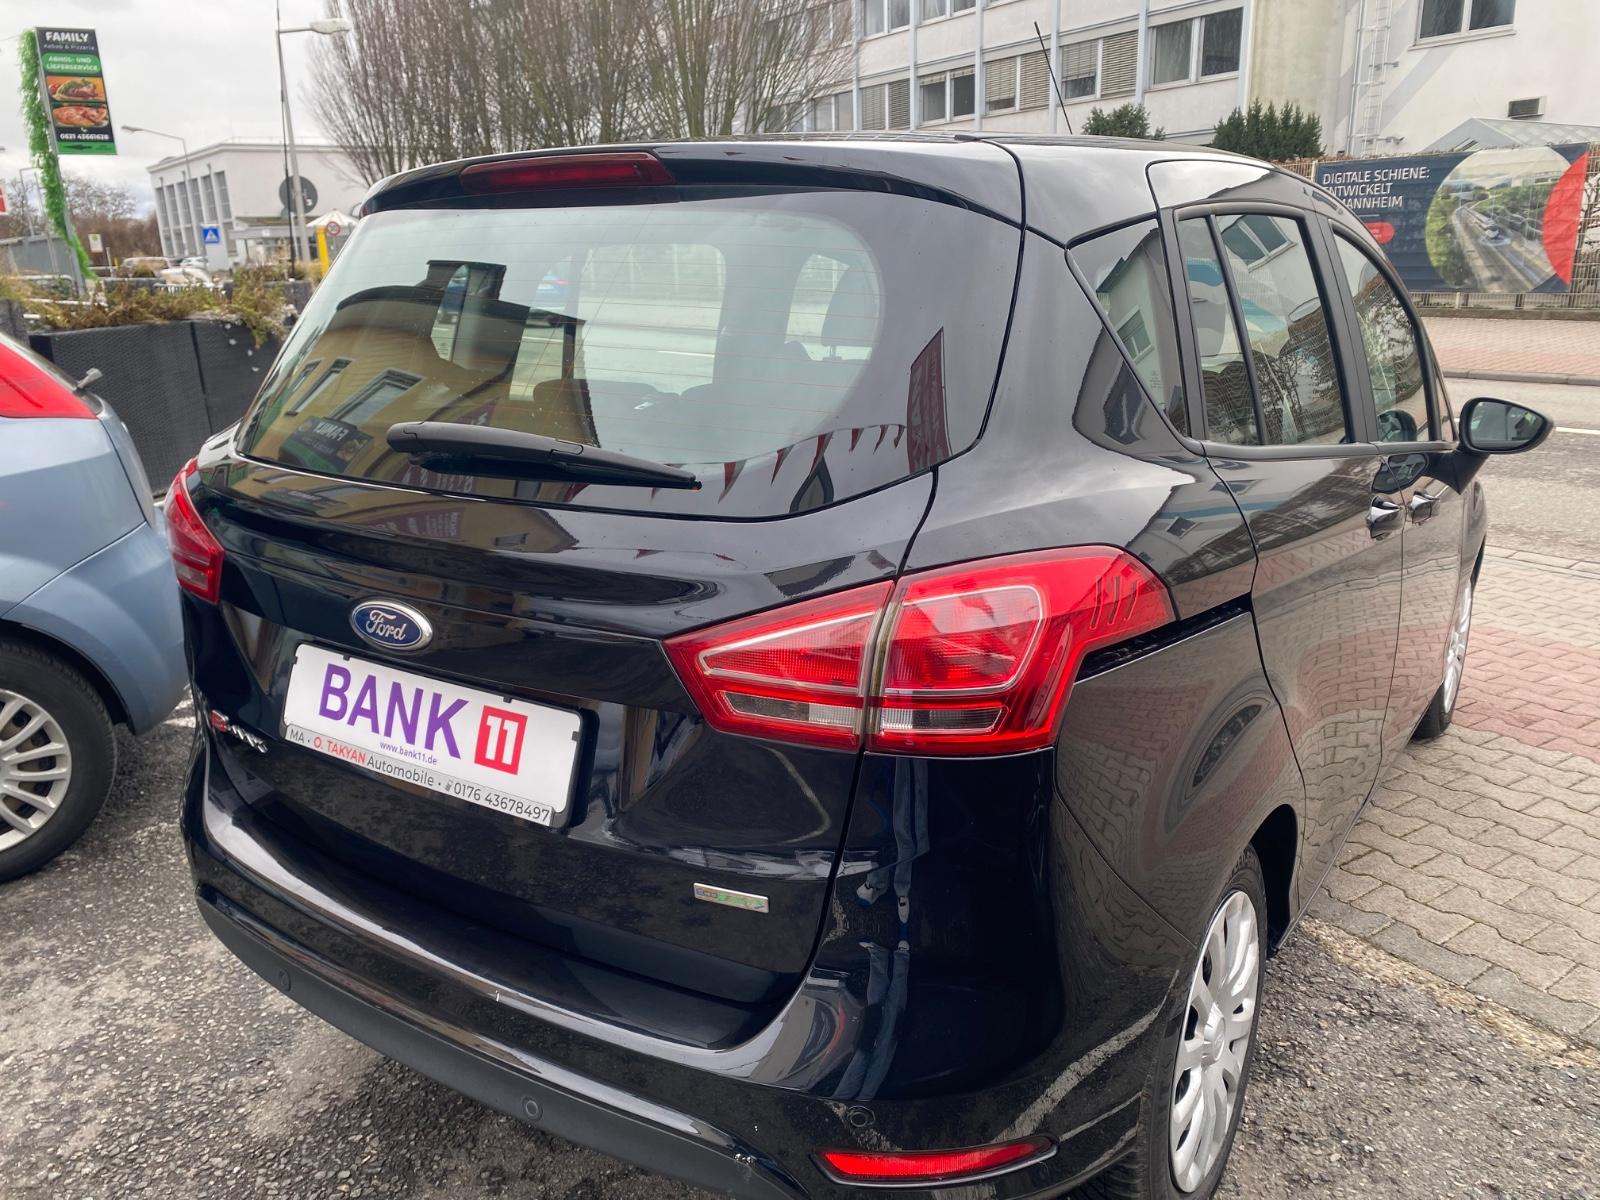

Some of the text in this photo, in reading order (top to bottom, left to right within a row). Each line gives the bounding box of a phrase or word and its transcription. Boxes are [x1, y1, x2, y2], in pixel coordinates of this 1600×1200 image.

[45, 31, 89, 43] FAMILY
[1323, 167, 1430, 184] DIGITALE SCHIENE:
[365, 609, 407, 641] Ford
[318, 662, 470, 760] BANK
[485, 714, 519, 766] 11
[380, 742, 437, 766] www.bank11.de
[289, 729, 305, 744] MA
[313, 736, 324, 750] O.
[326, 740, 367, 764] TAKYAN
[366, 756, 434, 787] Automobile
[454, 782, 482, 801] 0176
[485, 791, 551, 823] 43678497
